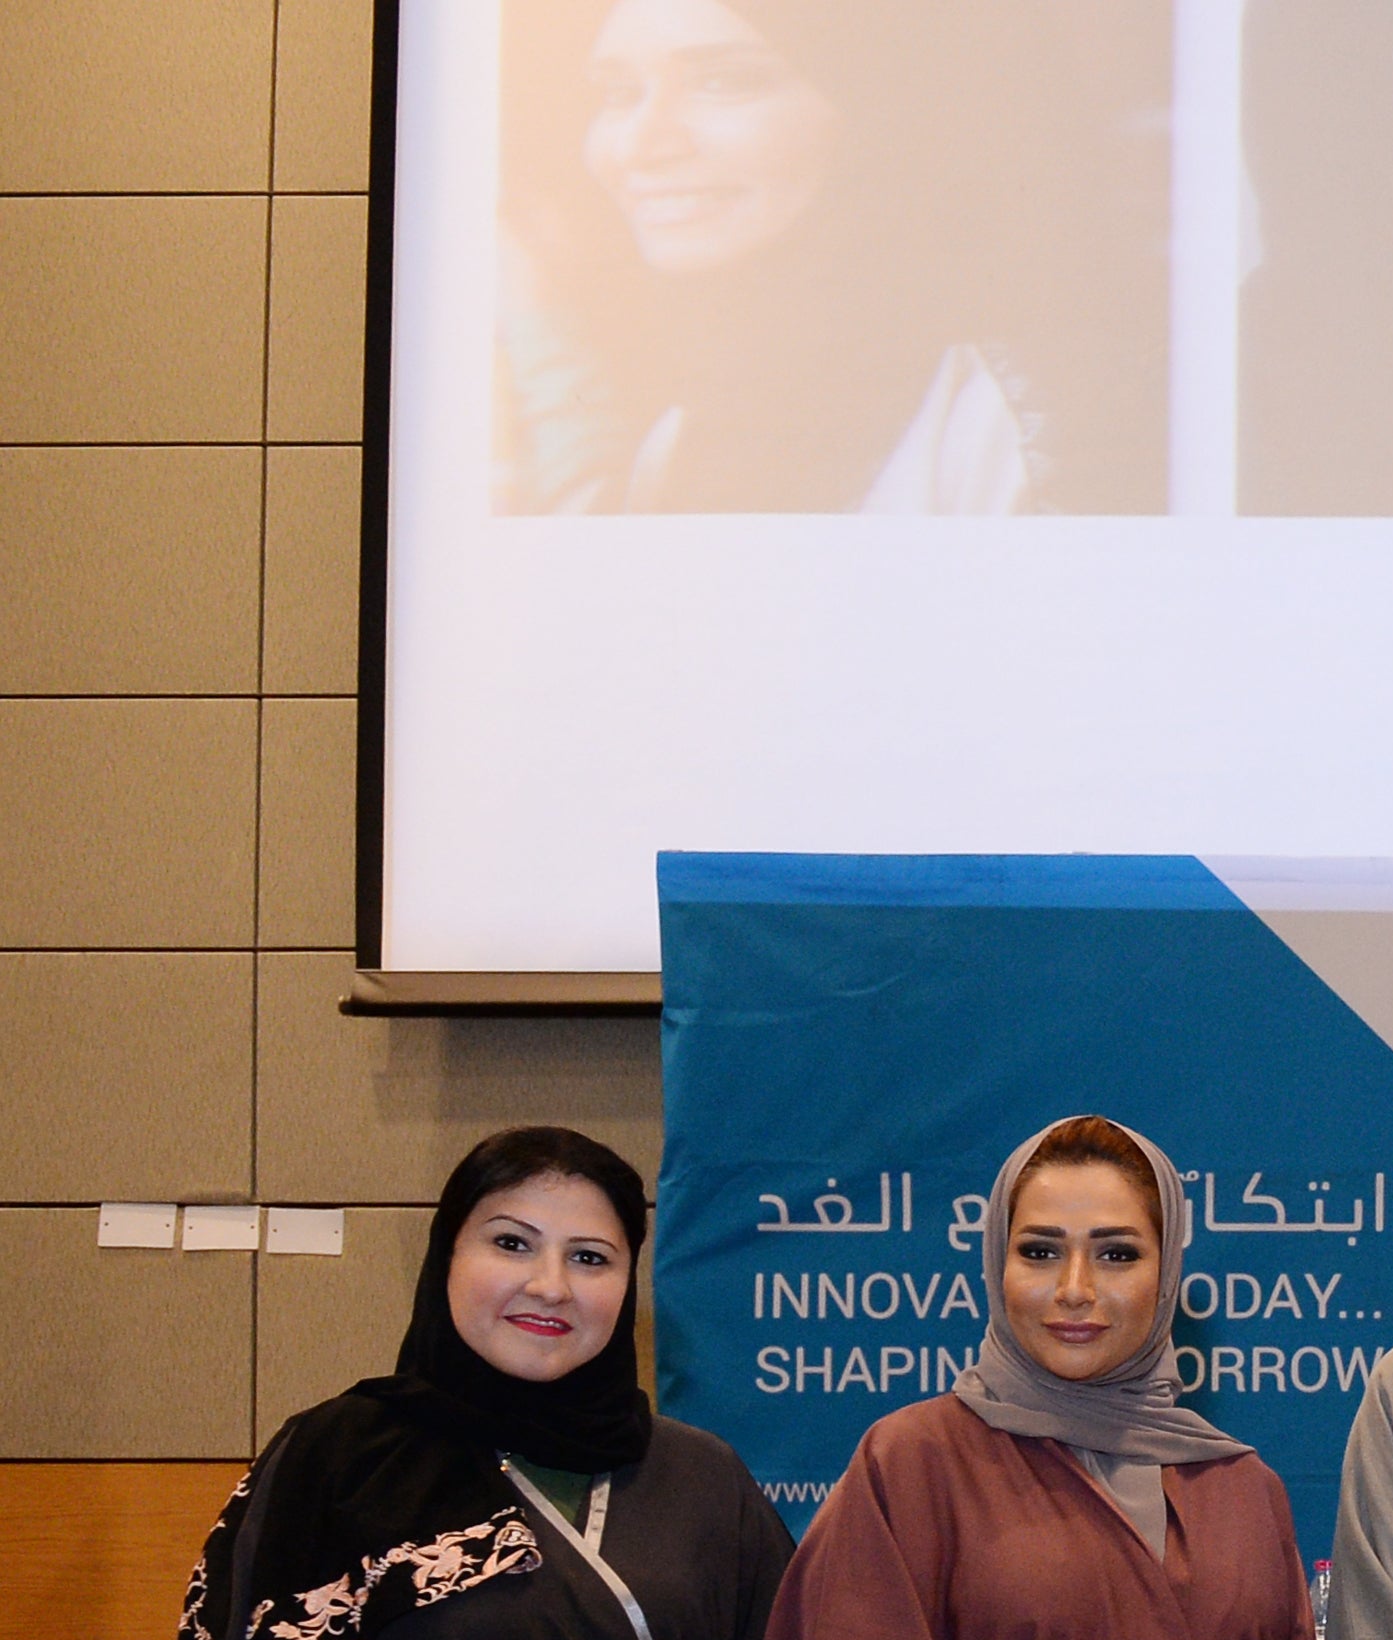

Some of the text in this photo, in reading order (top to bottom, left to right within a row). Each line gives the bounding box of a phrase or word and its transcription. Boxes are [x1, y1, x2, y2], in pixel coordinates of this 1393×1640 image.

[756, 1171, 912, 1233] الغد
[754, 1272, 1382, 1320] INNOVA ODAY...
[755, 1346, 1385, 1394] SHAPIN ORROW
